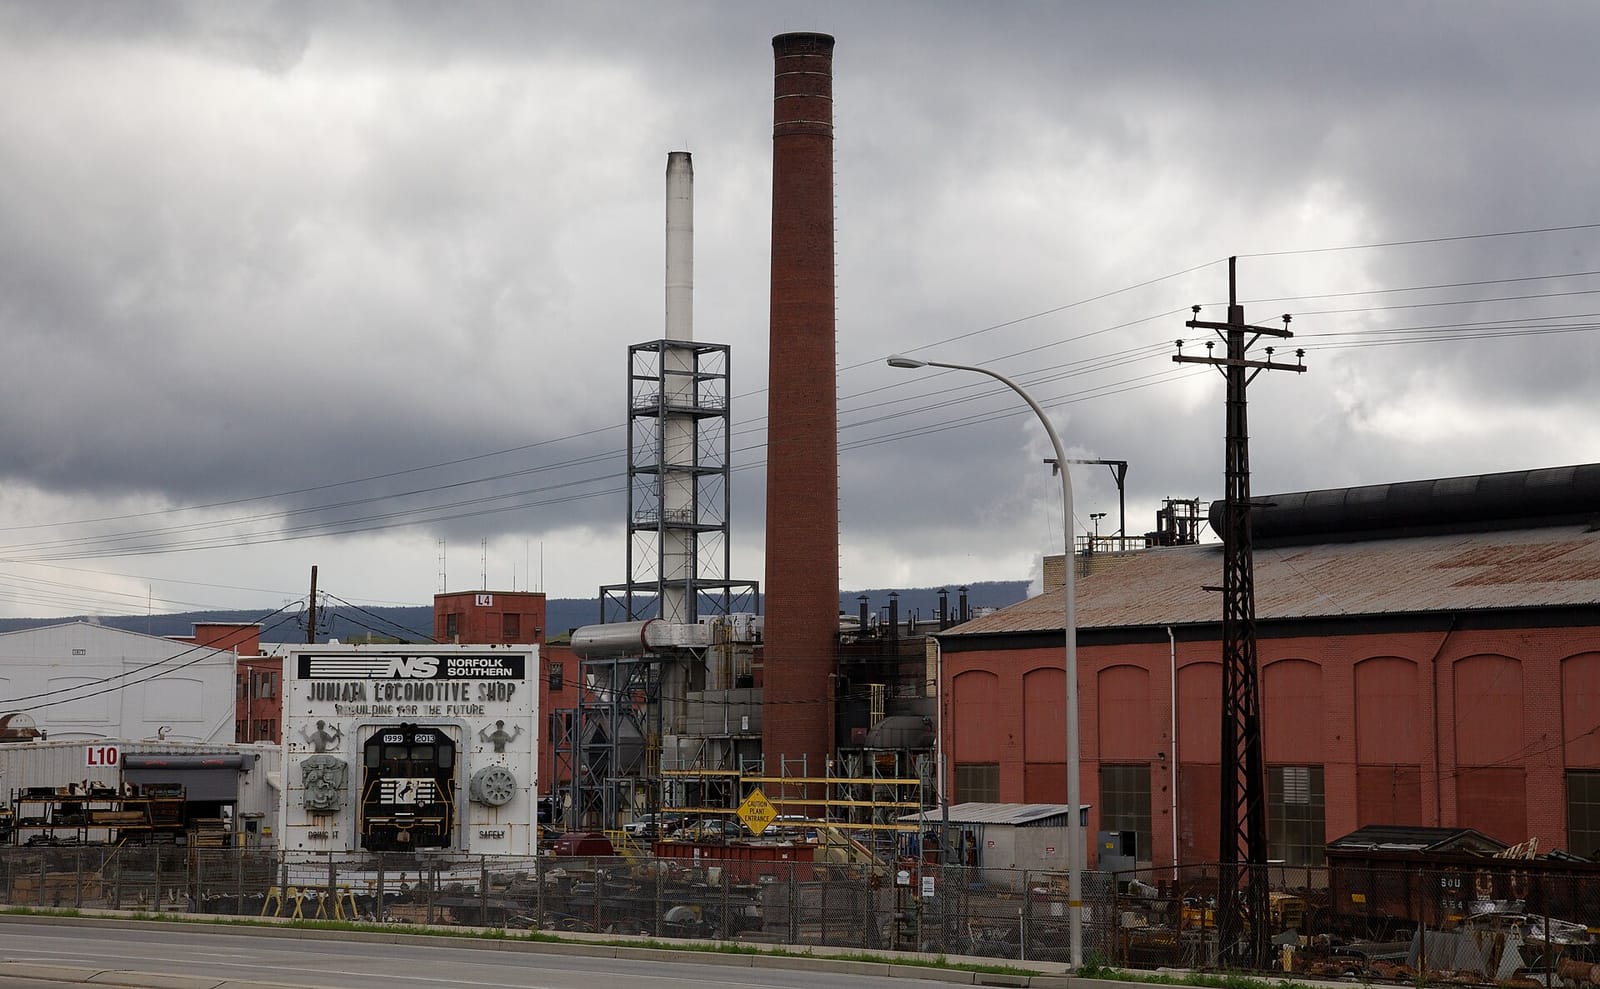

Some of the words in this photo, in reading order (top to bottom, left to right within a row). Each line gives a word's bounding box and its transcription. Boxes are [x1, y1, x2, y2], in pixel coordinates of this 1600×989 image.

[478, 595, 490, 605] L4
[387, 656, 440, 678] NS
[447, 658, 503, 667] NORFOLK
[447, 667, 513, 676] SOUTHERN
[306, 681, 367, 702] JUNIATA
[374, 681, 470, 702] LOCOMOTIVE
[478, 681, 516, 702] SHOP
[423, 704, 442, 716] THE
[446, 704, 485, 716] FUTURE
[88, 747, 117, 765] L10
[749, 807, 765, 815] PLANT
[744, 814, 770, 823] ENTRANCE
[332, 830, 339, 840] IT
[1440, 878, 1461, 888] SOU
